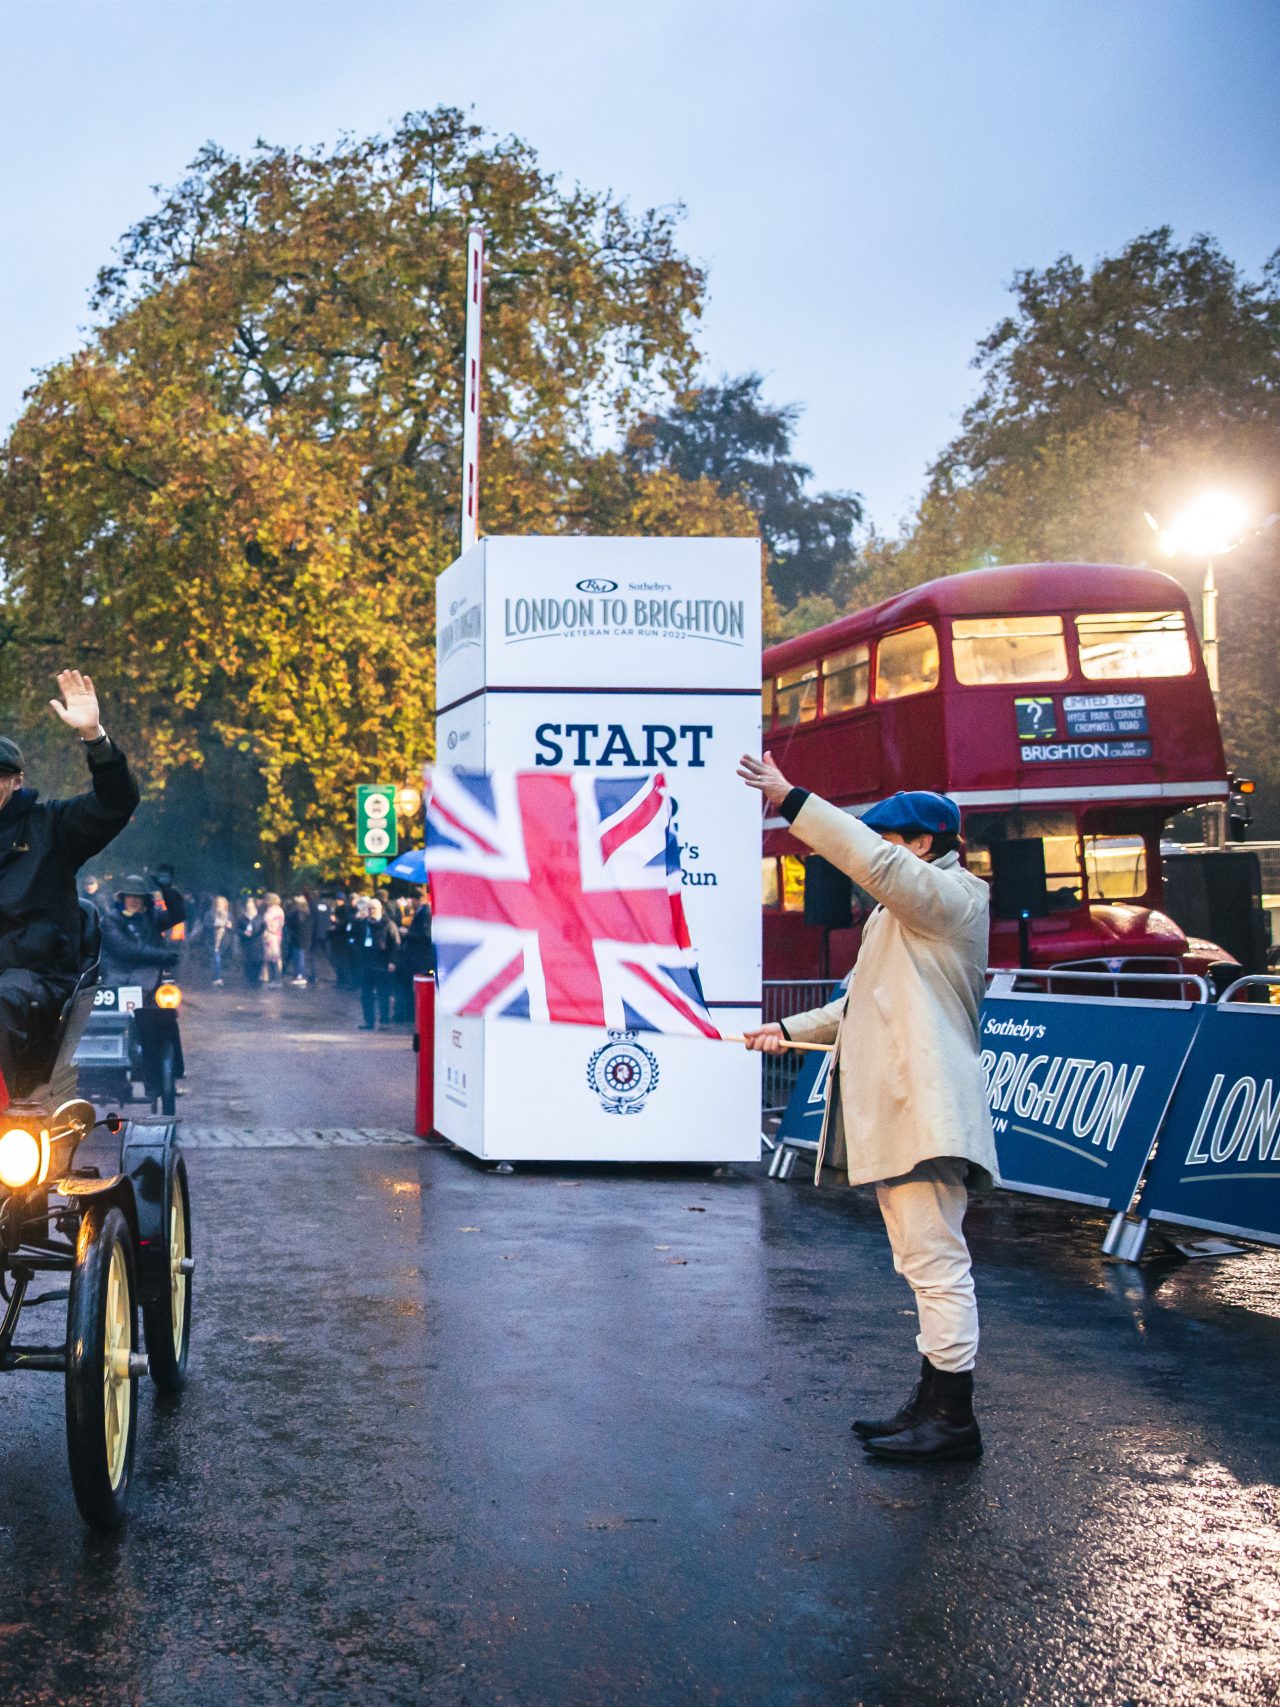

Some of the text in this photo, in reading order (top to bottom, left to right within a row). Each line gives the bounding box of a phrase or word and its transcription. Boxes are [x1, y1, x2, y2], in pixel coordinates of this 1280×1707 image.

[628, 582, 672, 593] Sotheby's
[505, 598, 595, 637] LONDON
[599, 599, 628, 626] TO
[634, 599, 745, 640] BRIGHTON
[562, 628, 687, 640] VETERAN CAR RUN 2022
[1067, 709, 1144, 723] HYDE PARK CORNER
[1074, 721, 1140, 733] CROMWELL ROAD
[535, 723, 713, 767] START
[1021, 743, 1109, 761] BRIGHTON
[984, 1018, 1047, 1041] Sotheby's
[1184, 1073, 1280, 1165] LON
